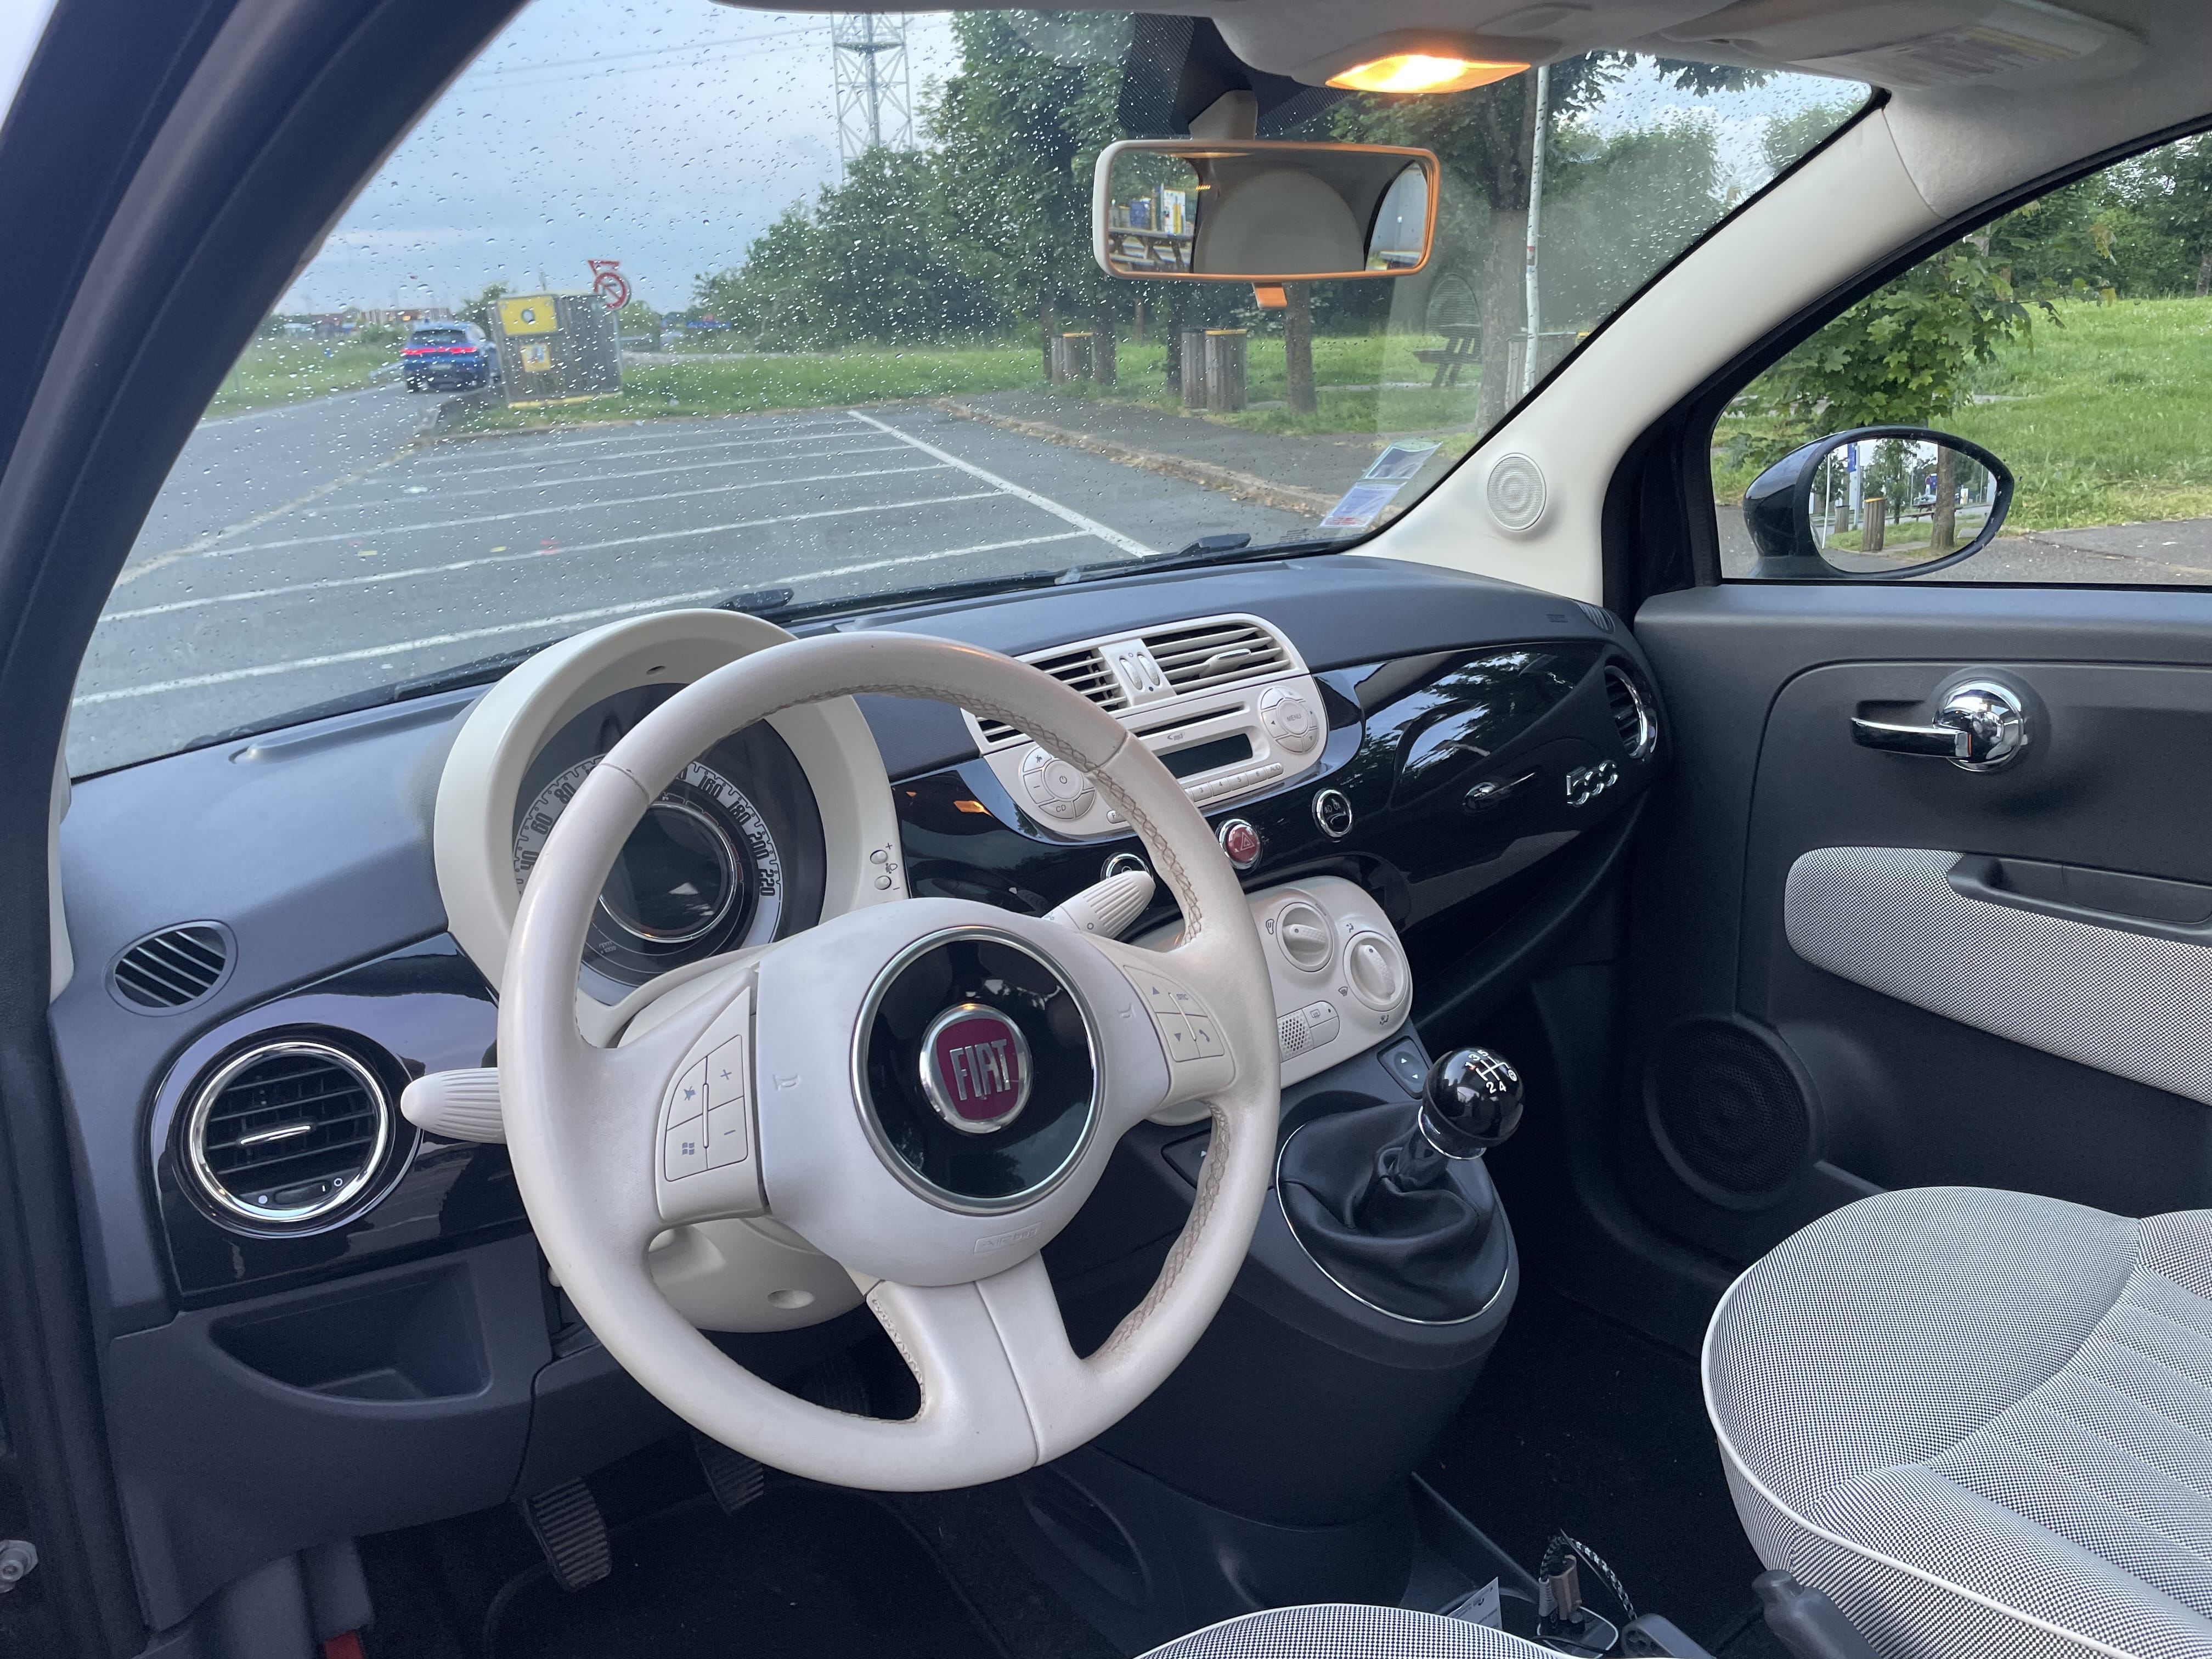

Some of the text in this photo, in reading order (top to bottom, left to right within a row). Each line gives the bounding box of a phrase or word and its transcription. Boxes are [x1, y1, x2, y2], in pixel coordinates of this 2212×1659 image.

[554, 782, 576, 804] 80
[698, 775, 724, 797] 160
[1566, 760, 1619, 808] 500
[729, 799, 752, 823] 180
[1056, 804, 1066, 812] CD
[531, 812, 553, 835] 60
[749, 831, 770, 860] 200
[520, 850, 540, 871] 40
[759, 869, 775, 896] 220
[949, 1039, 1012, 1101] FIAT
[1486, 1081, 1506, 1093] 2 4
